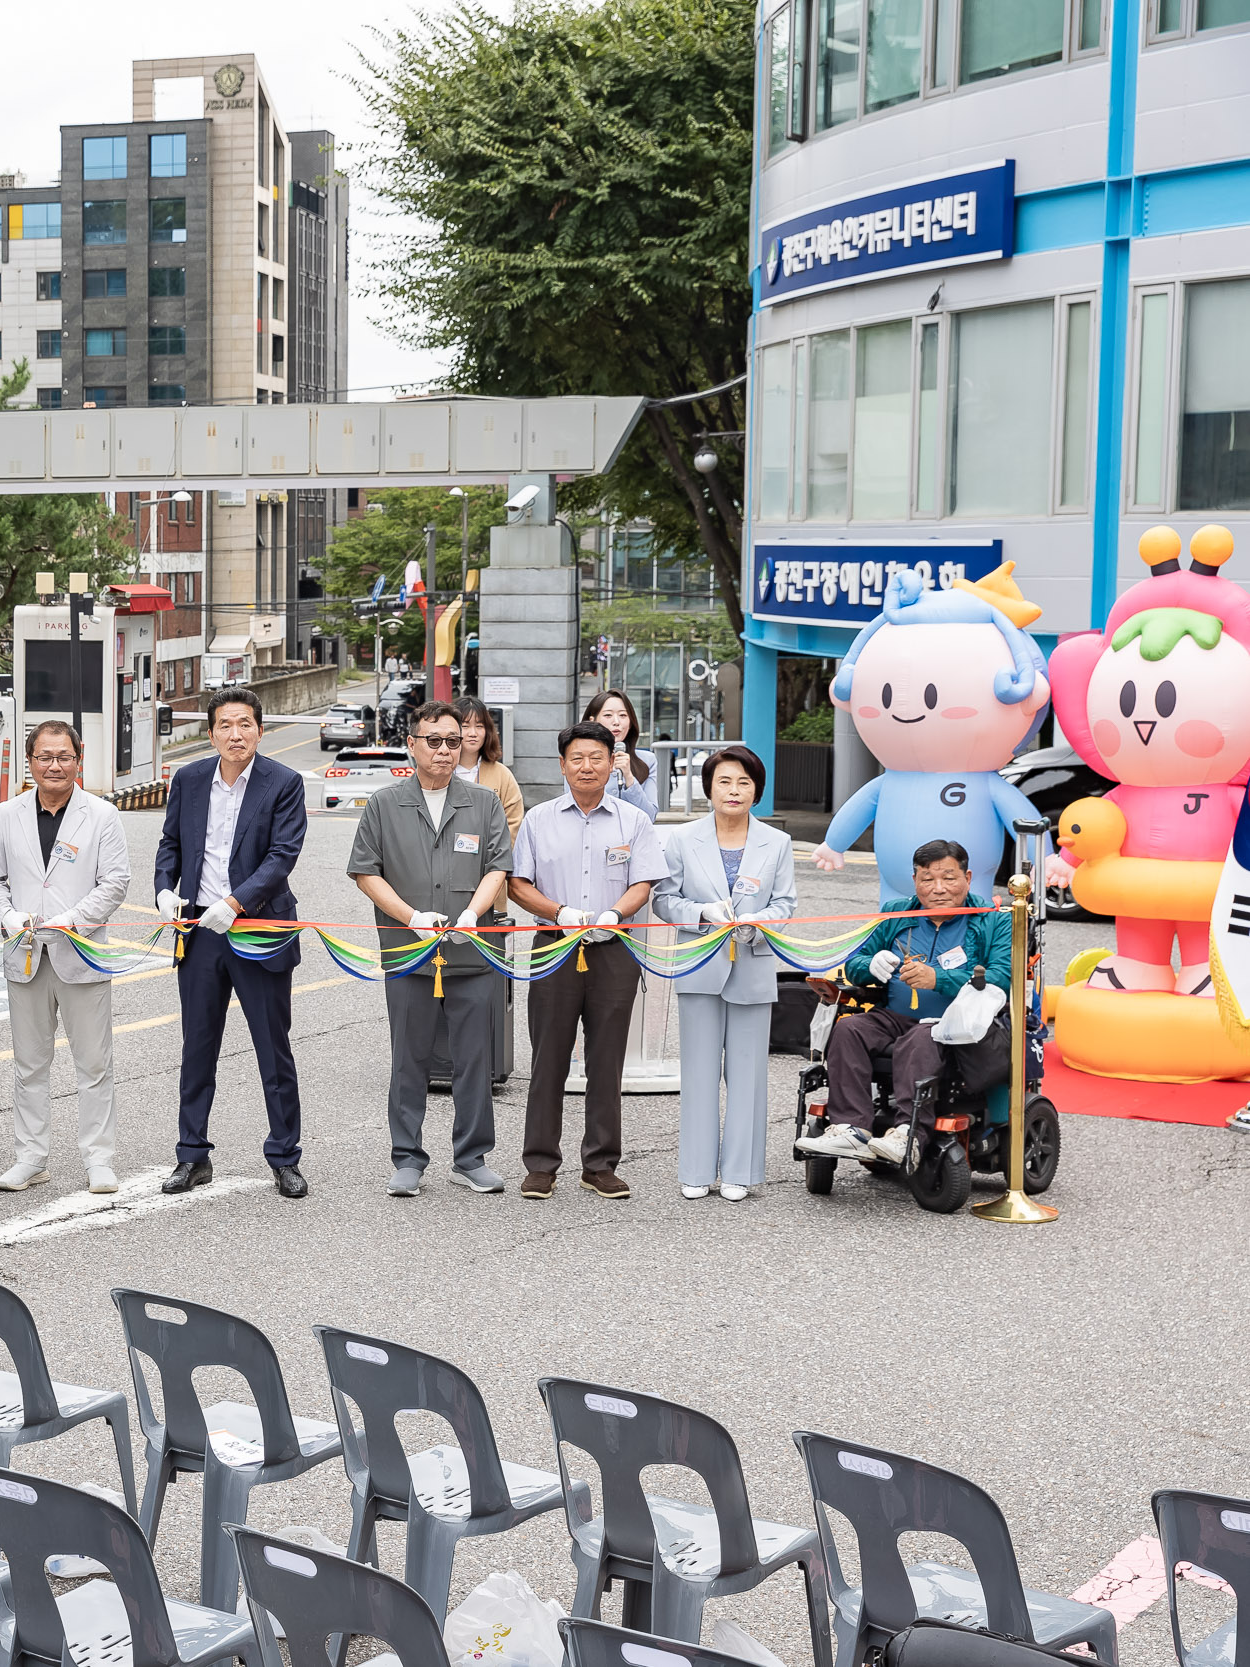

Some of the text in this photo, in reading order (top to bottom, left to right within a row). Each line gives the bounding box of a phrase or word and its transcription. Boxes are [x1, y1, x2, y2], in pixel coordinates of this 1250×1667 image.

[44, 622, 88, 630] PARKG
[940, 782, 967, 808] G
[1183, 793, 1210, 815] J
